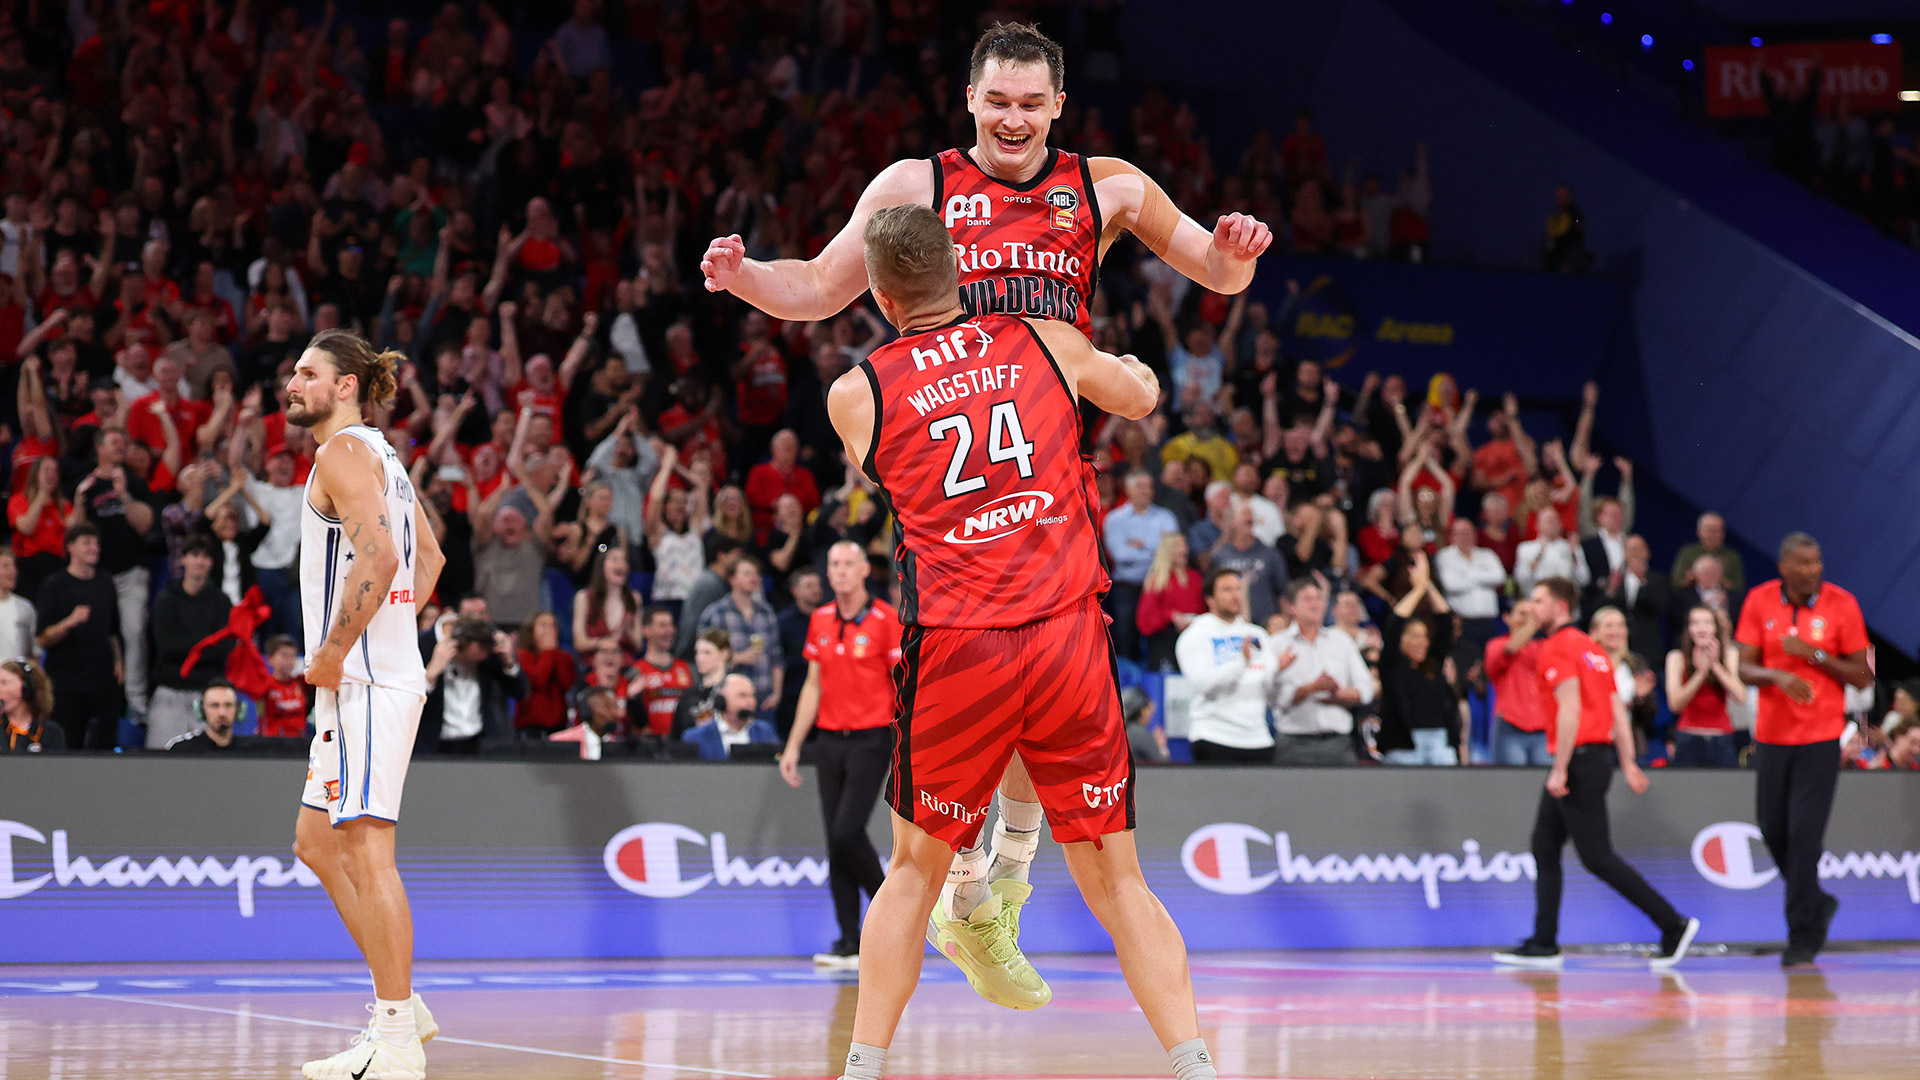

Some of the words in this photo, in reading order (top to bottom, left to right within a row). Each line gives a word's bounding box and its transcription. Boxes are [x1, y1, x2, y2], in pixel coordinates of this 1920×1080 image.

[1002, 195, 1032, 204] OPTUS
[1052, 194, 1072, 207] NBL
[966, 218, 992, 226] bank
[958, 276, 1080, 325] WILDCATS
[911, 330, 969, 372] hif
[906, 364, 1023, 417] WAGSTAFF
[928, 399, 1034, 500] 24
[963, 499, 1037, 538] NRW
[1035, 514, 1068, 526] Holdings
